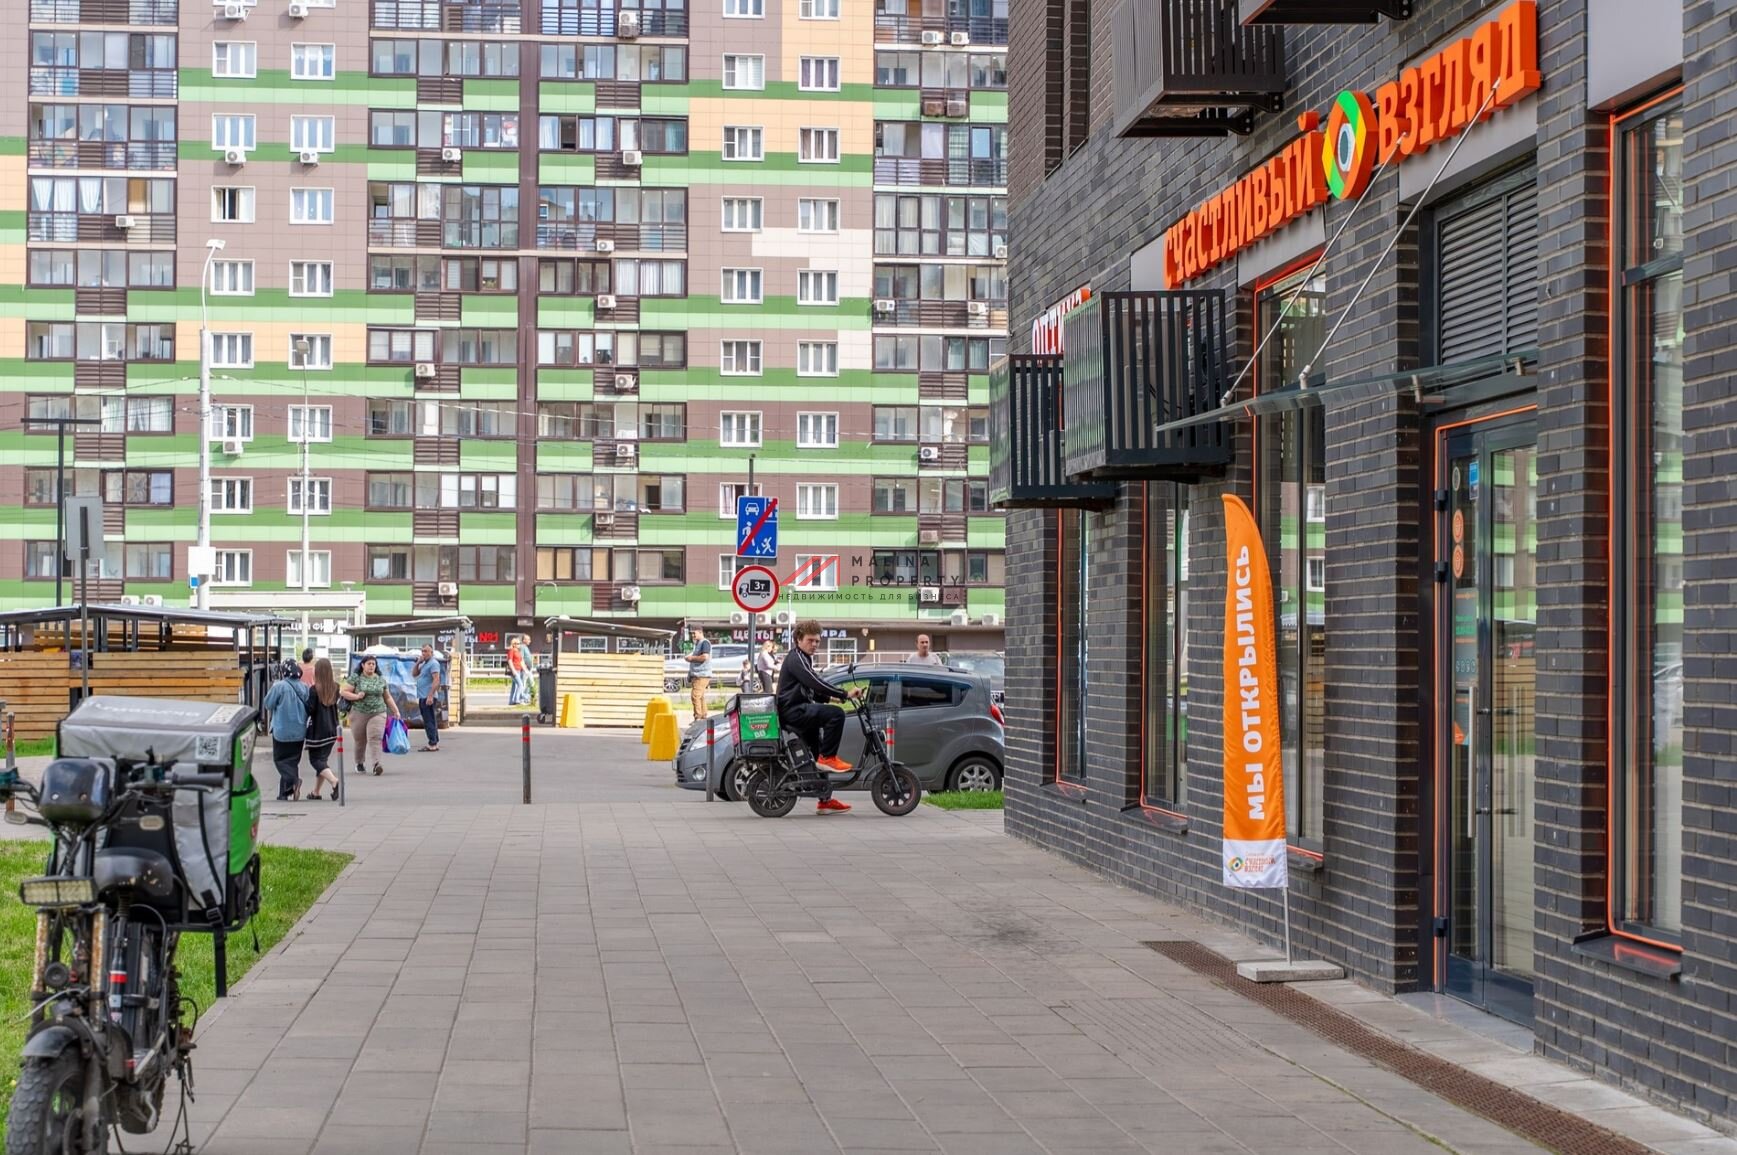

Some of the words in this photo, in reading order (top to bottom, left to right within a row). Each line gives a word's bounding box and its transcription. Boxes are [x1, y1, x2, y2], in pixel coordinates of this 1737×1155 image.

[1376, 0, 1527, 164] ВЗГЛЯД
[1032, 287, 1083, 355] ОПТИ
[733, 629, 774, 641] ЦВТЫ
[1236, 545, 1262, 753] ОТКРЫЛИСЬ
[1247, 763, 1265, 820] МЫ
